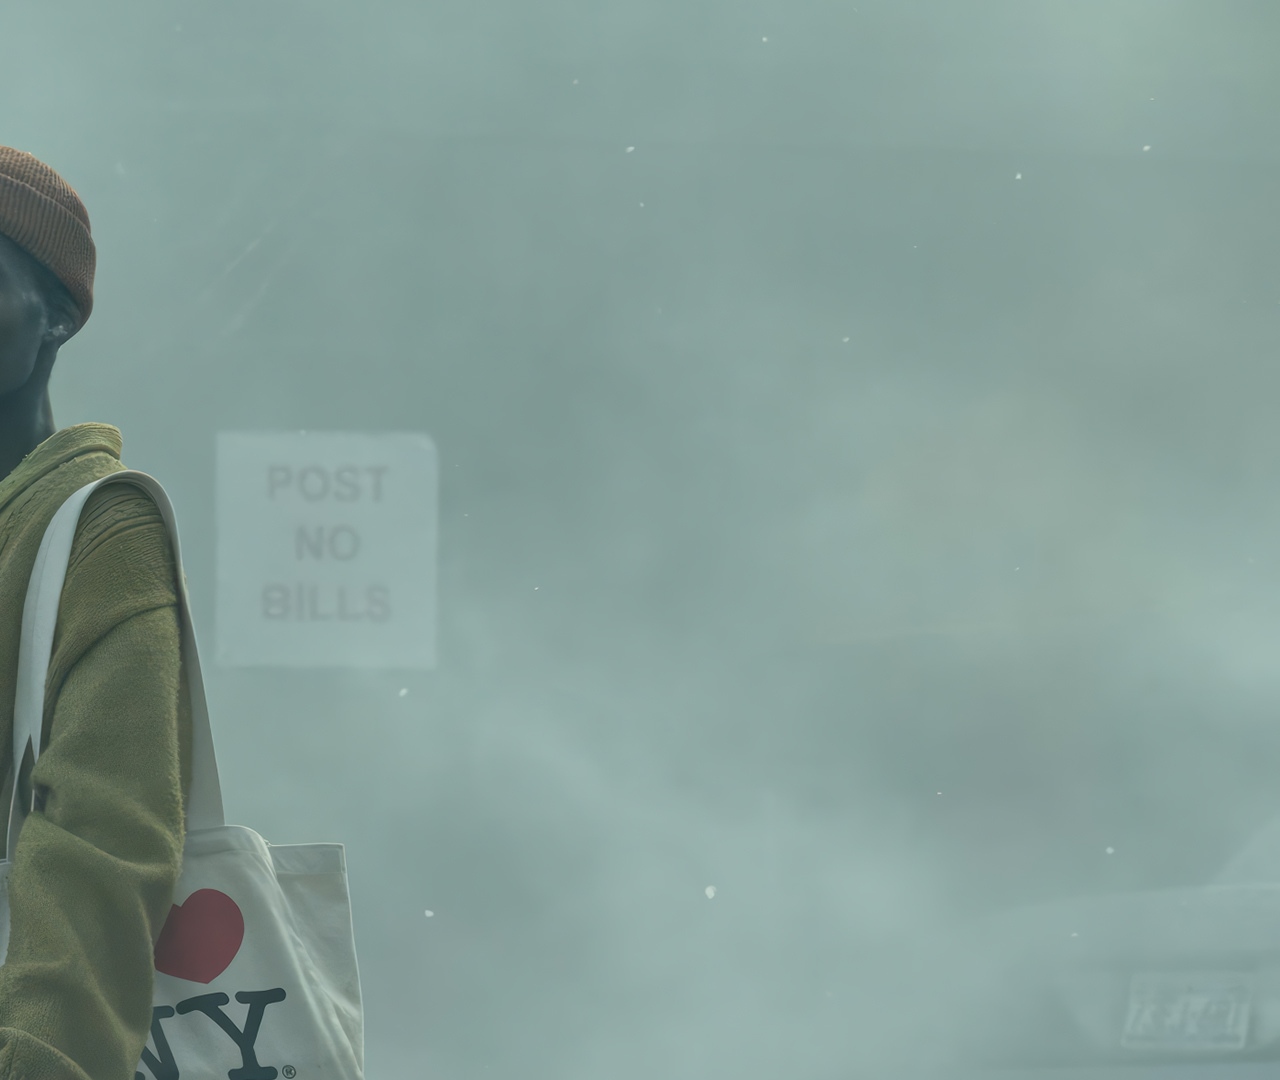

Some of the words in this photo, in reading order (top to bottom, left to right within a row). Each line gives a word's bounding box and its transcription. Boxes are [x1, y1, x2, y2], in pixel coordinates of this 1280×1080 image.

[267, 465, 388, 503] POST
[295, 525, 361, 562] NO
[262, 583, 391, 623] BILLS
